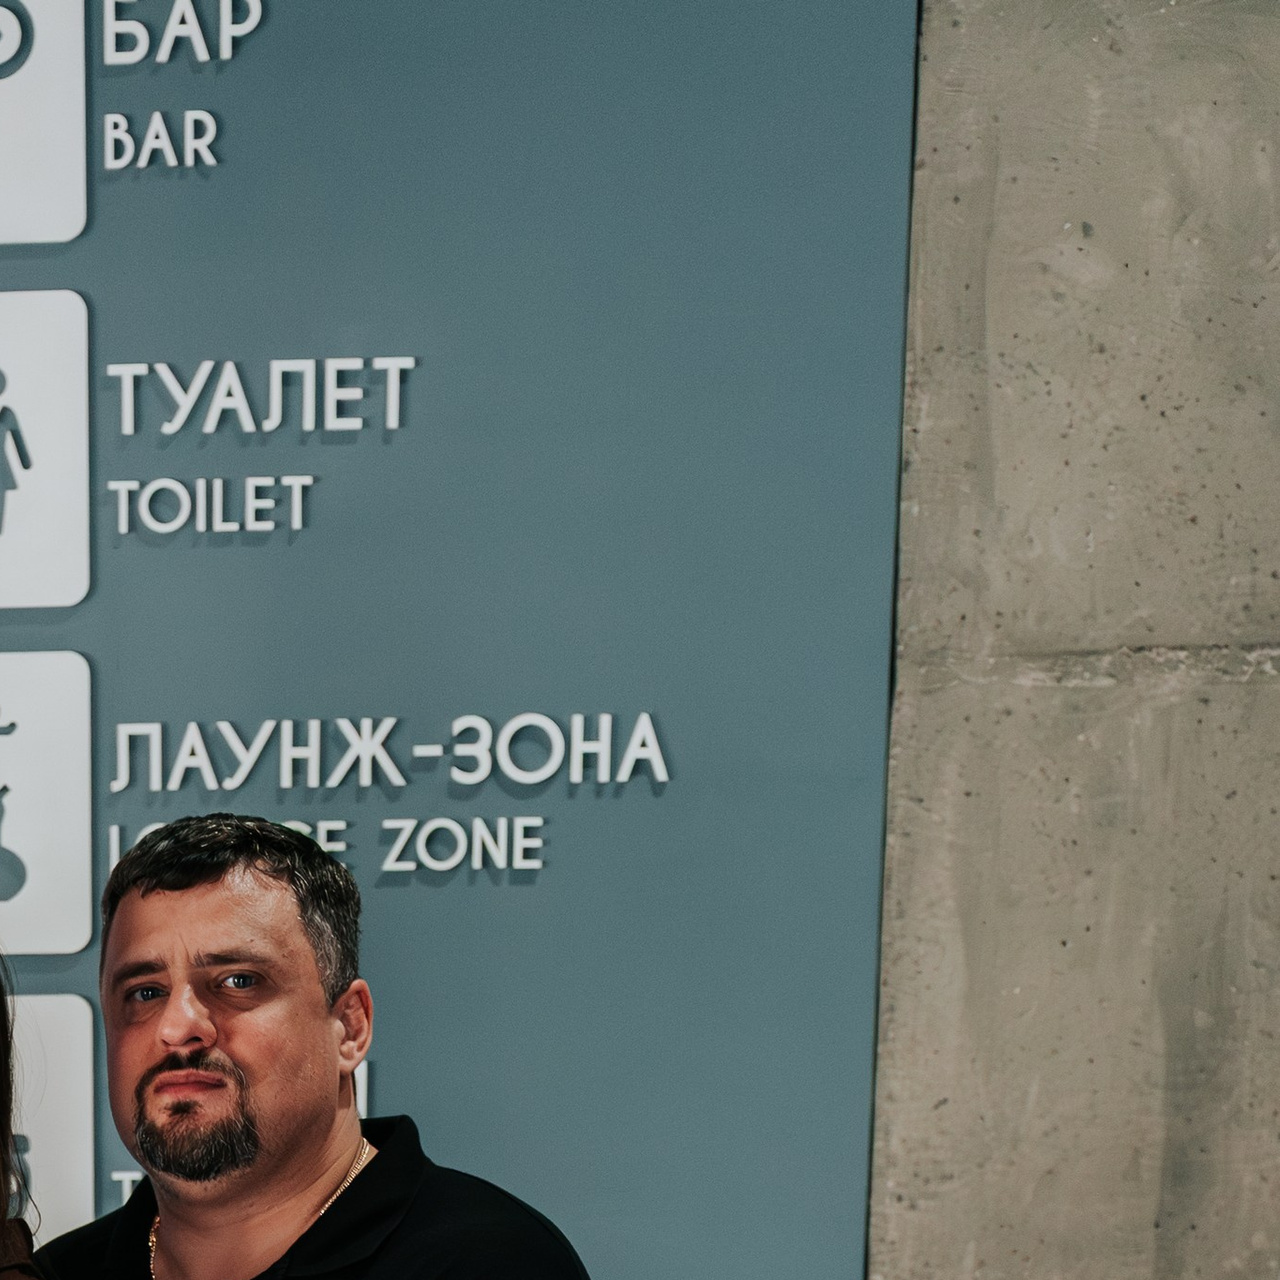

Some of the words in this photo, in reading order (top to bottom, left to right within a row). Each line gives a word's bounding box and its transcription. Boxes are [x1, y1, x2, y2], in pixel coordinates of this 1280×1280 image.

[104, 0, 263, 65] БАР
[104, 109, 218, 170] BAR
[106, 356, 416, 436] ТУАЛЕТ
[107, 475, 314, 535] TOILET
[110, 711, 669, 793] ЛАУНЖ-ЗОНА
[381, 816, 545, 872] ZONE
